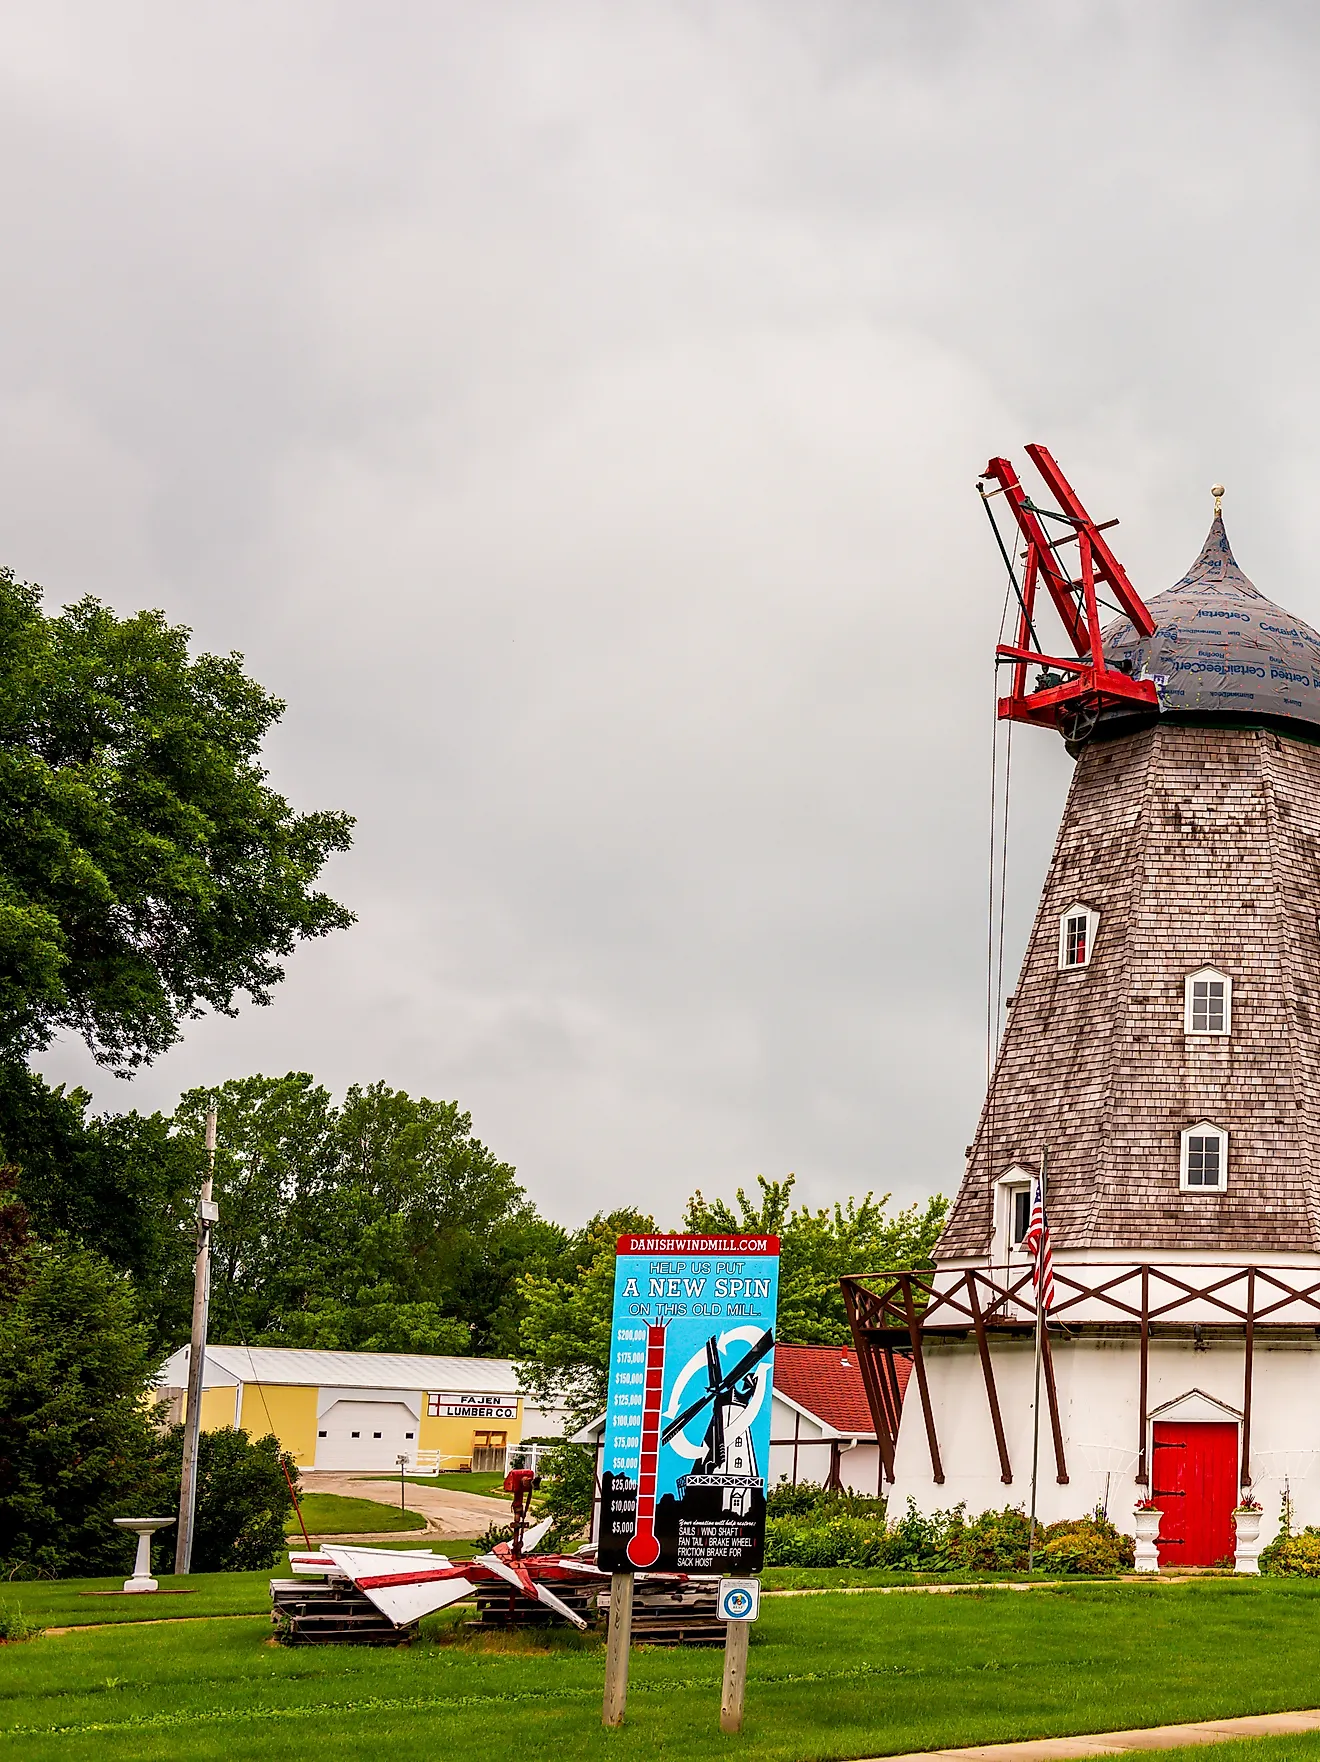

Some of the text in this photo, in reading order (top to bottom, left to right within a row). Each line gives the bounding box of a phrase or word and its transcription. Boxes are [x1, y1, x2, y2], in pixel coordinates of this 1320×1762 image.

[1198, 650, 1224, 658] Roofing
[630, 1239, 767, 1251] DANISHWINDMILL.COM
[650, 1262, 745, 1274] HELP US PUT
[622, 1278, 771, 1298] A NEW SPIN
[629, 1303, 761, 1316] ON THIS OLD MILL.
[616, 1352, 644, 1364] $175,000
[616, 1372, 644, 1385] $150,000
[461, 1396, 500, 1404] FAJEN
[614, 1394, 642, 1407] $125,000
[447, 1407, 514, 1417] LUMBER CO.
[612, 1414, 640, 1428] $100,000
[614, 1436, 638, 1449] $75,000
[613, 1457, 638, 1470] $50,000
[612, 1479, 636, 1492] $25,000
[610, 1500, 636, 1513] $10,000
[612, 1521, 634, 1534] $5,000
[678, 1527, 738, 1536] SAILS WIND SHAFT
[678, 1538, 752, 1547] FAN TAIL BRAKE WHEEL
[678, 1548, 742, 1557] FRICTION BRAKE FOR
[677, 1558, 713, 1566] SACK HOIST
